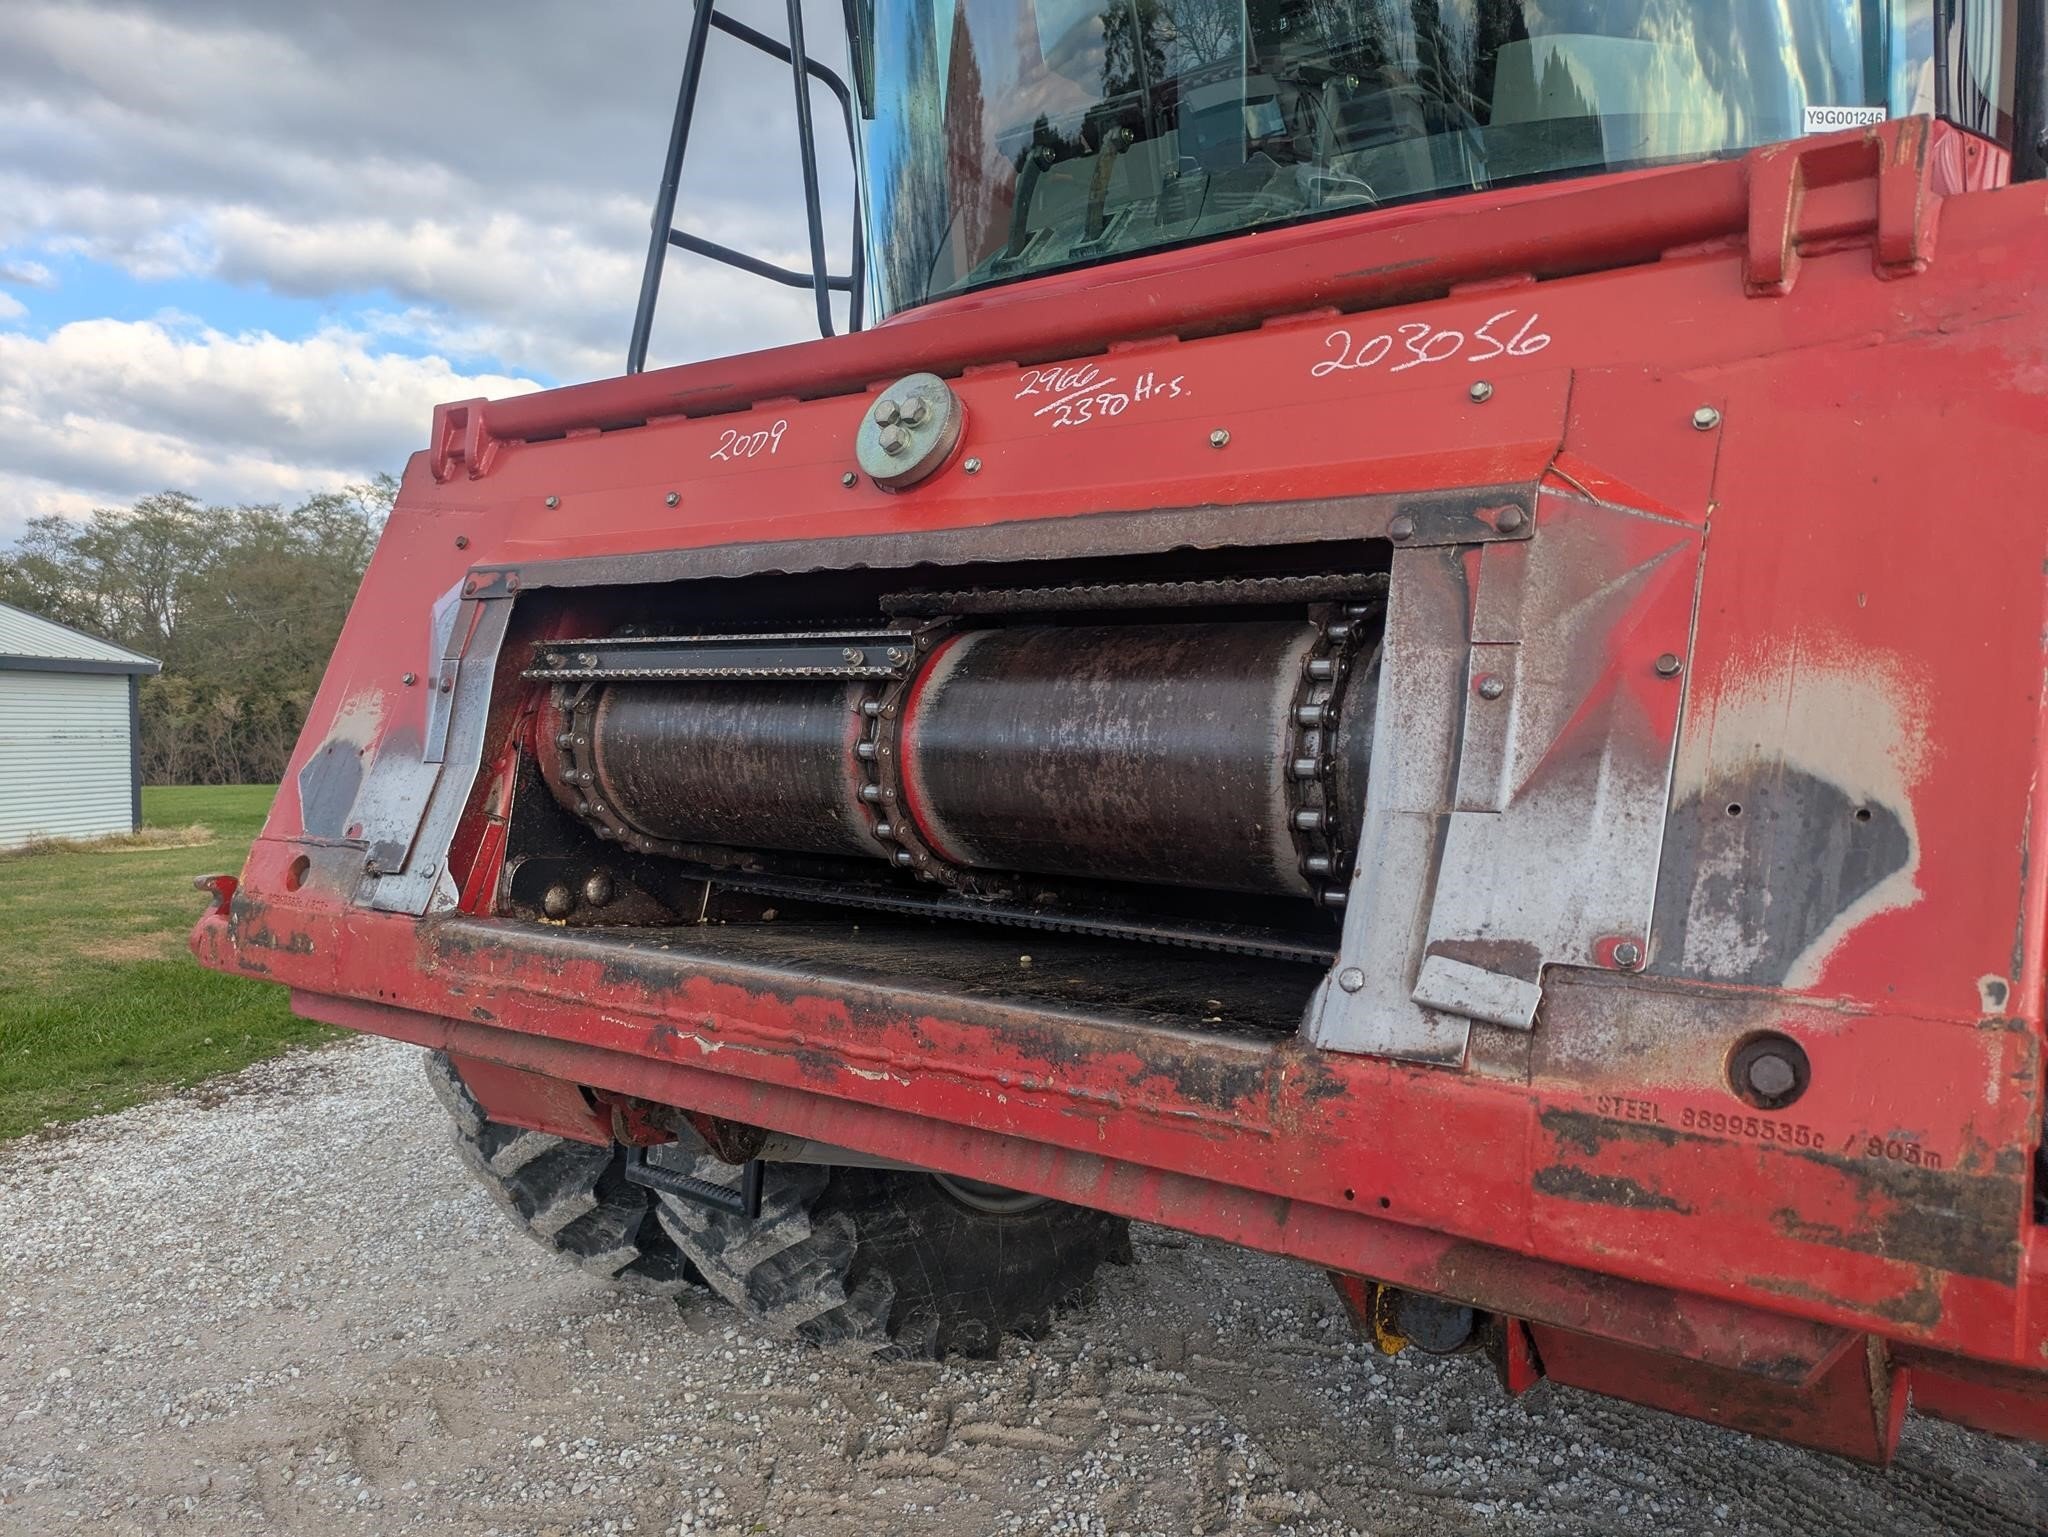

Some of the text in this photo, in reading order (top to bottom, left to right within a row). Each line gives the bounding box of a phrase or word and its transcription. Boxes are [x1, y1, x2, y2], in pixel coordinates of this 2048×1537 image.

[1807, 110, 1883, 125] Y9G001246
[1311, 309, 1551, 377] 203056
[1052, 393, 1130, 428] 2390
[710, 419, 788, 461] 2009
[1597, 1095, 1666, 1124] STEEL
